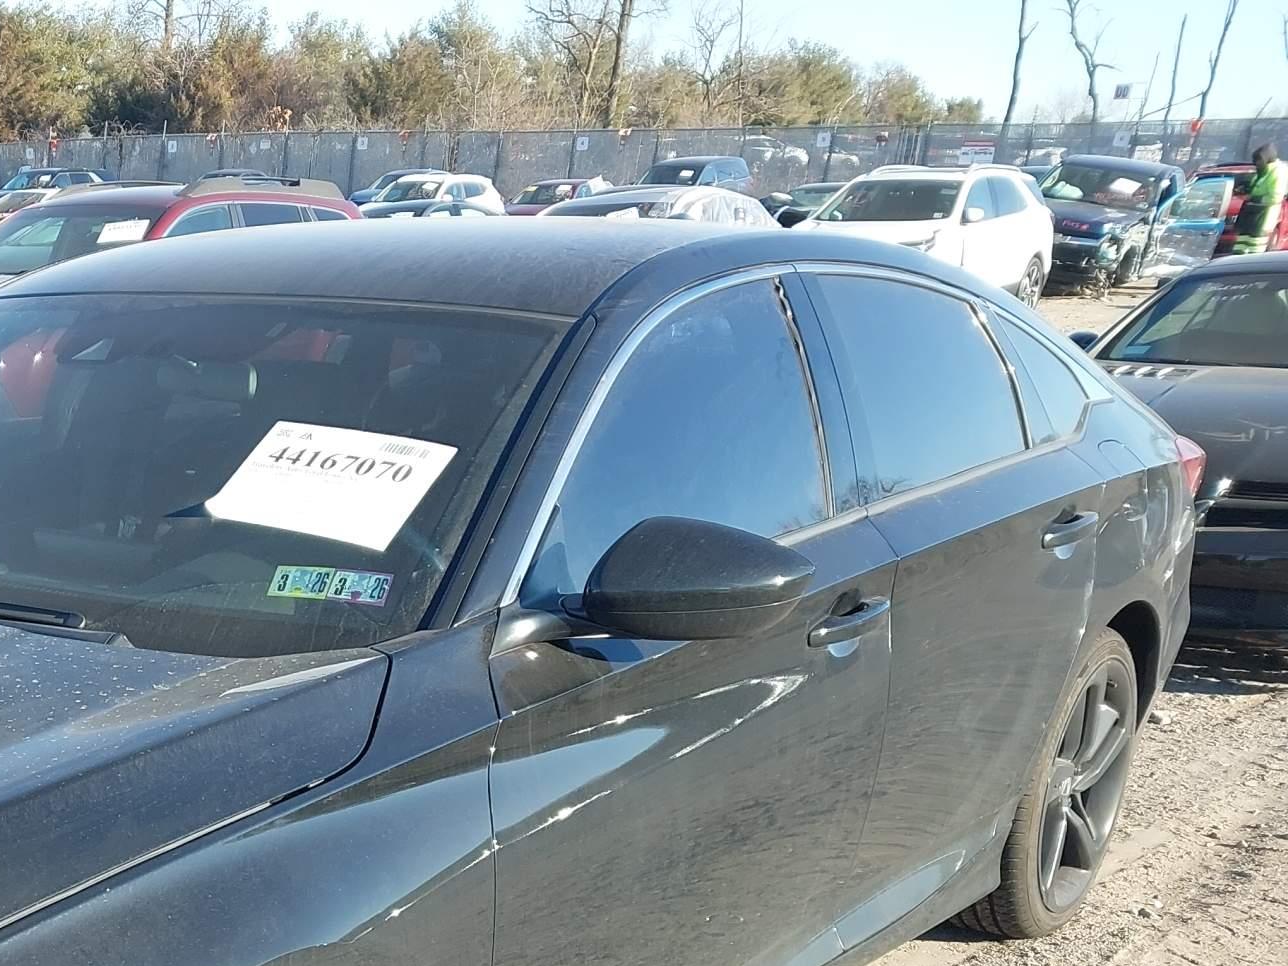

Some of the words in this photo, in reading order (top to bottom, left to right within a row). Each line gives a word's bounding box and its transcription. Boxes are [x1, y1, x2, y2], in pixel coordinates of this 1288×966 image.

[268, 446, 413, 483] 44167070
[277, 573, 290, 592] 3
[311, 572, 330, 594] 26
[334, 577, 348, 596] 3
[368, 577, 389, 600] 26
